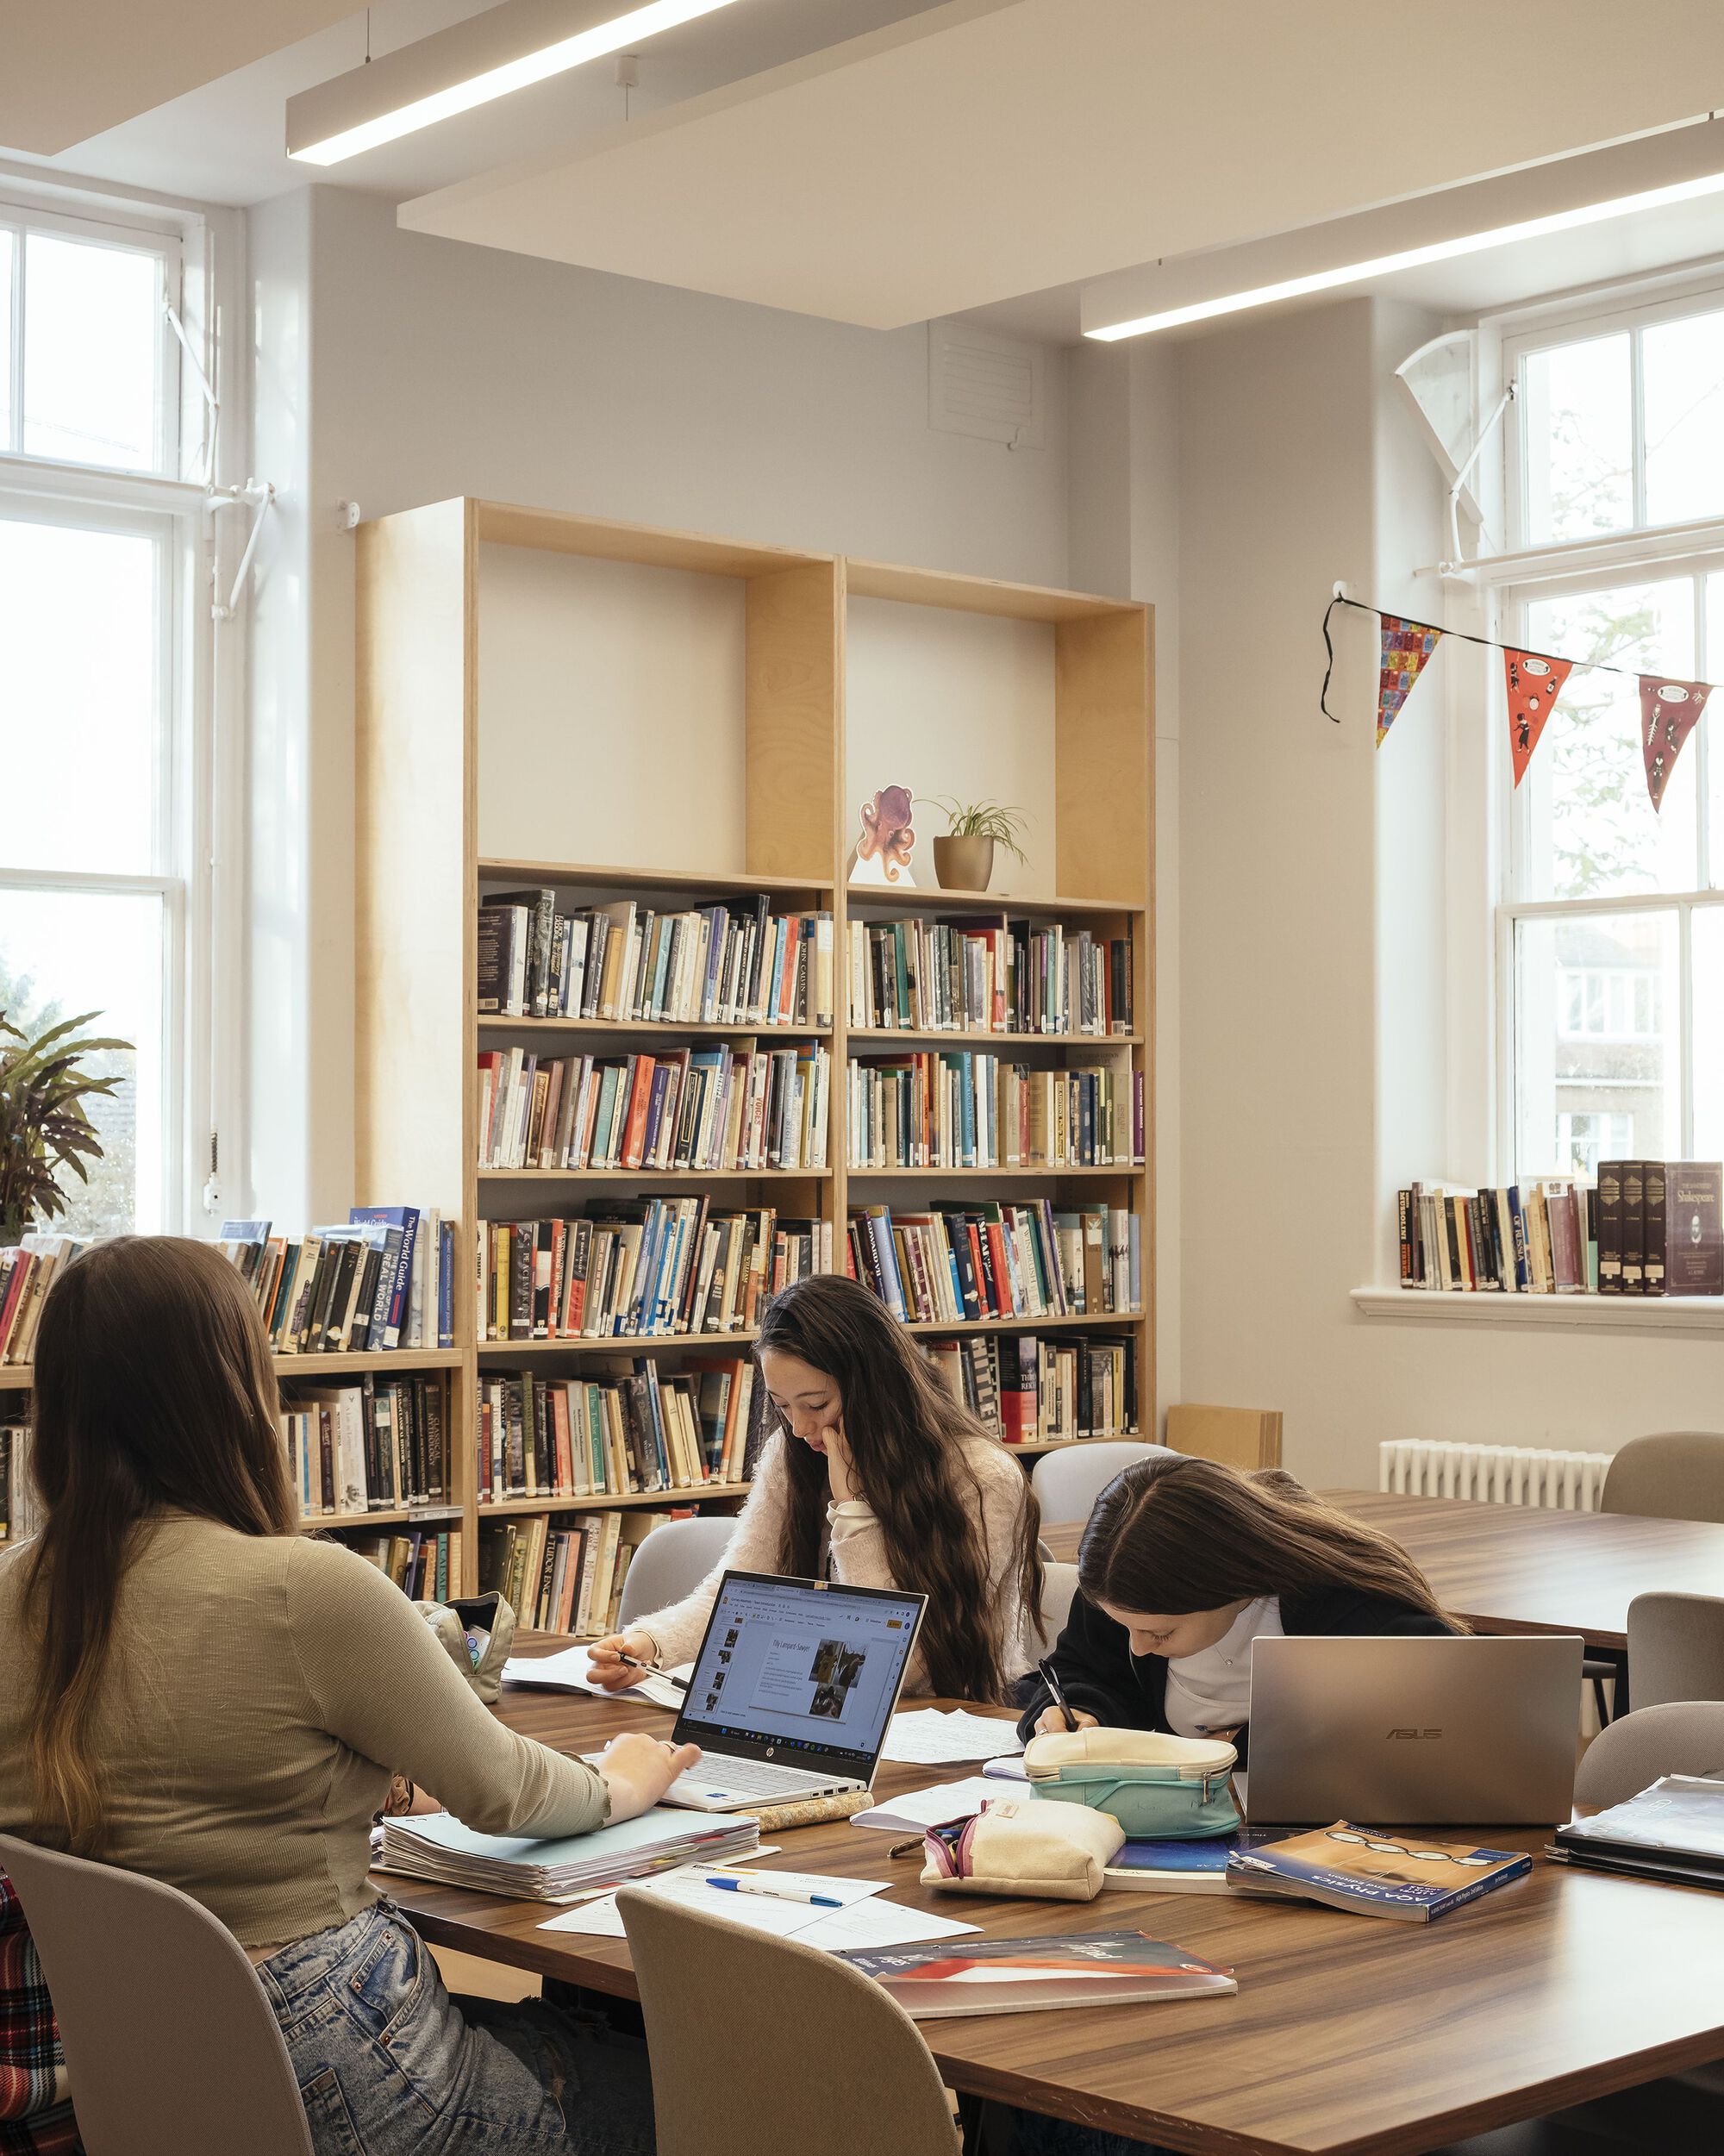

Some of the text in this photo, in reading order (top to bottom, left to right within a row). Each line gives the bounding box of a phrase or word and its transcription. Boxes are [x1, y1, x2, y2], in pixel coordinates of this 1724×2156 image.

[754, 1097, 764, 1125] VOICES
[1677, 1190, 1715, 1205] Shakespeare
[395, 1215, 416, 1291] The World Guide
[866, 1221, 879, 1263] EDWARD
[1513, 1215, 1524, 1262] OF RUSSIA
[354, 1240, 370, 1277] Pasternak
[1022, 1228, 1037, 1284] WINDRUSH
[373, 1253, 392, 1322] REAL WORLD
[386, 1271, 396, 1294] ATLAS
[522, 1253, 530, 1319] PEACEMAKERS
[382, 1306, 390, 1322] THE
[384, 1295, 392, 1305] OF
[971, 1337, 999, 1430] HITLER
[592, 1438, 602, 1483] Constitutio
[544, 1540, 556, 1573] TUDOR
[1385, 1728, 1442, 1740] ASUS
[1349, 1825, 1387, 1839] OXFORD
[1310, 1873, 1430, 1903] AQA Physics
[1326, 1872, 1388, 1890] 2nd Edition
